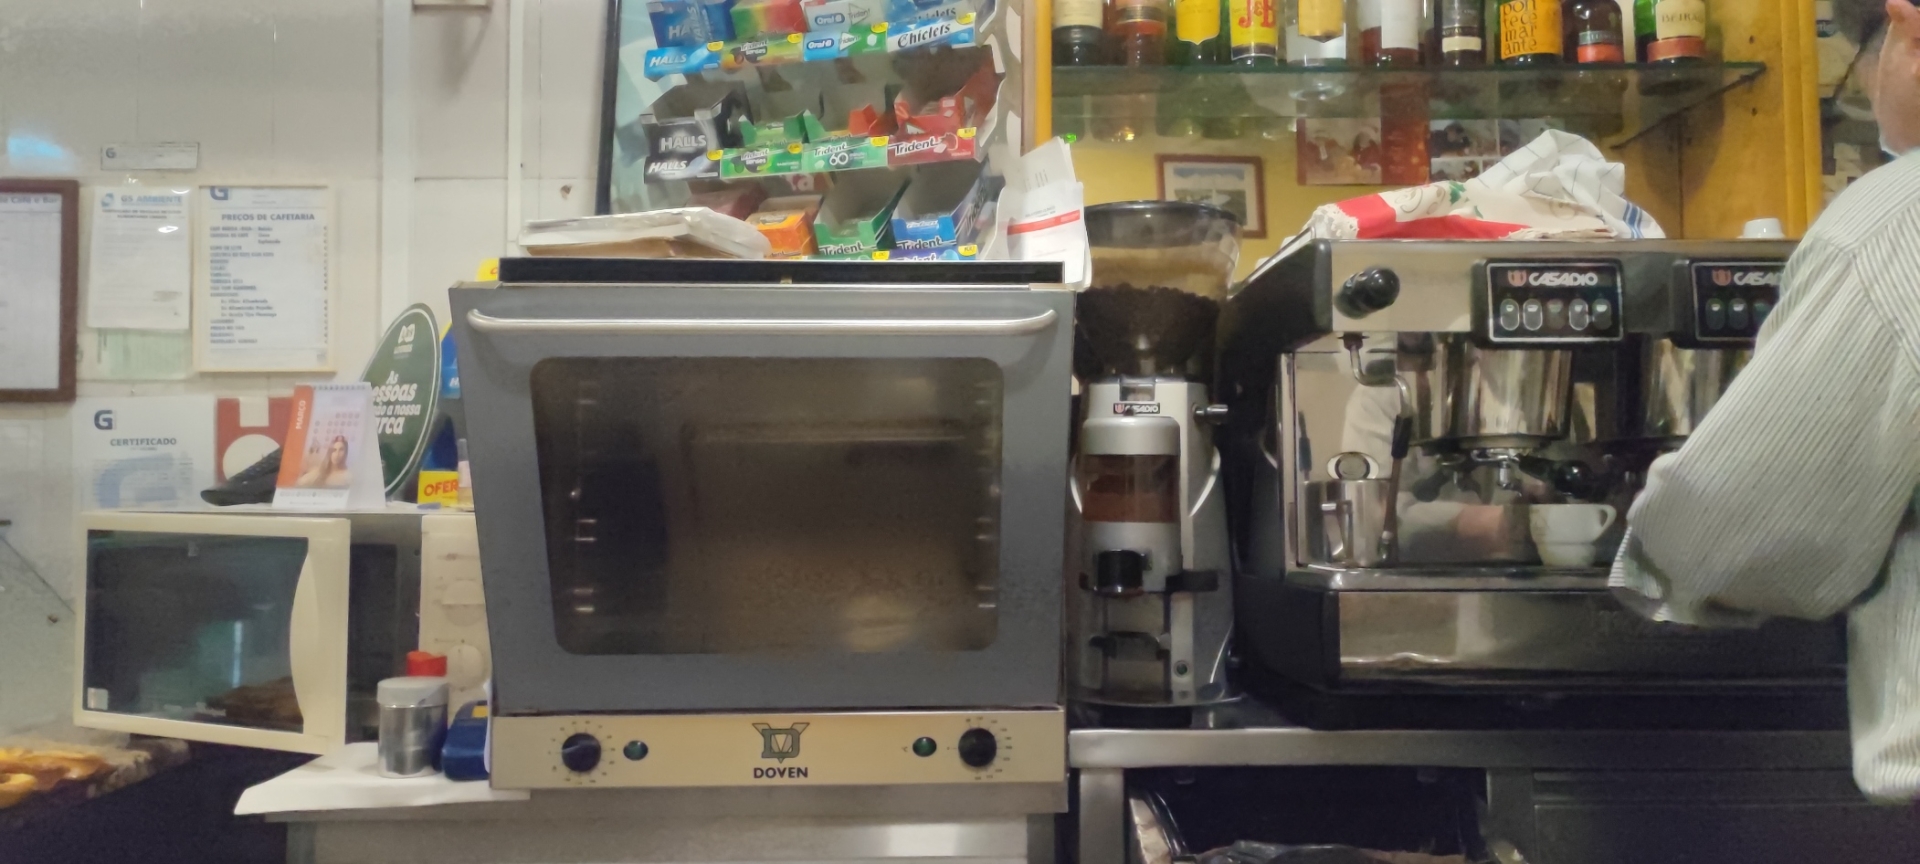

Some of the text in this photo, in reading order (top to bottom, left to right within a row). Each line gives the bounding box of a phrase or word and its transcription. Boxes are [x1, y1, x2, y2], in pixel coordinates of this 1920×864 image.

[897, 22, 951, 48] Chiclets
[650, 53, 688, 68] HALLS
[660, 134, 707, 150] HALLS
[895, 135, 938, 156] Trident
[741, 148, 770, 161] Trident
[814, 142, 848, 157] Trident
[829, 152, 849, 166] 60
[648, 160, 688, 174] HALLS
[221, 213, 315, 222] PREÇOS DE CAFETARIA
[823, 241, 864, 256] Trident
[902, 236, 942, 250] Trident
[1528, 272, 1598, 286] CASADIO
[386, 370, 399, 384] As
[373, 383, 418, 402] essoas
[394, 404, 421, 416] nossa
[110, 438, 177, 446] CERTIFICADO
[753, 766, 808, 779] DOVEN
